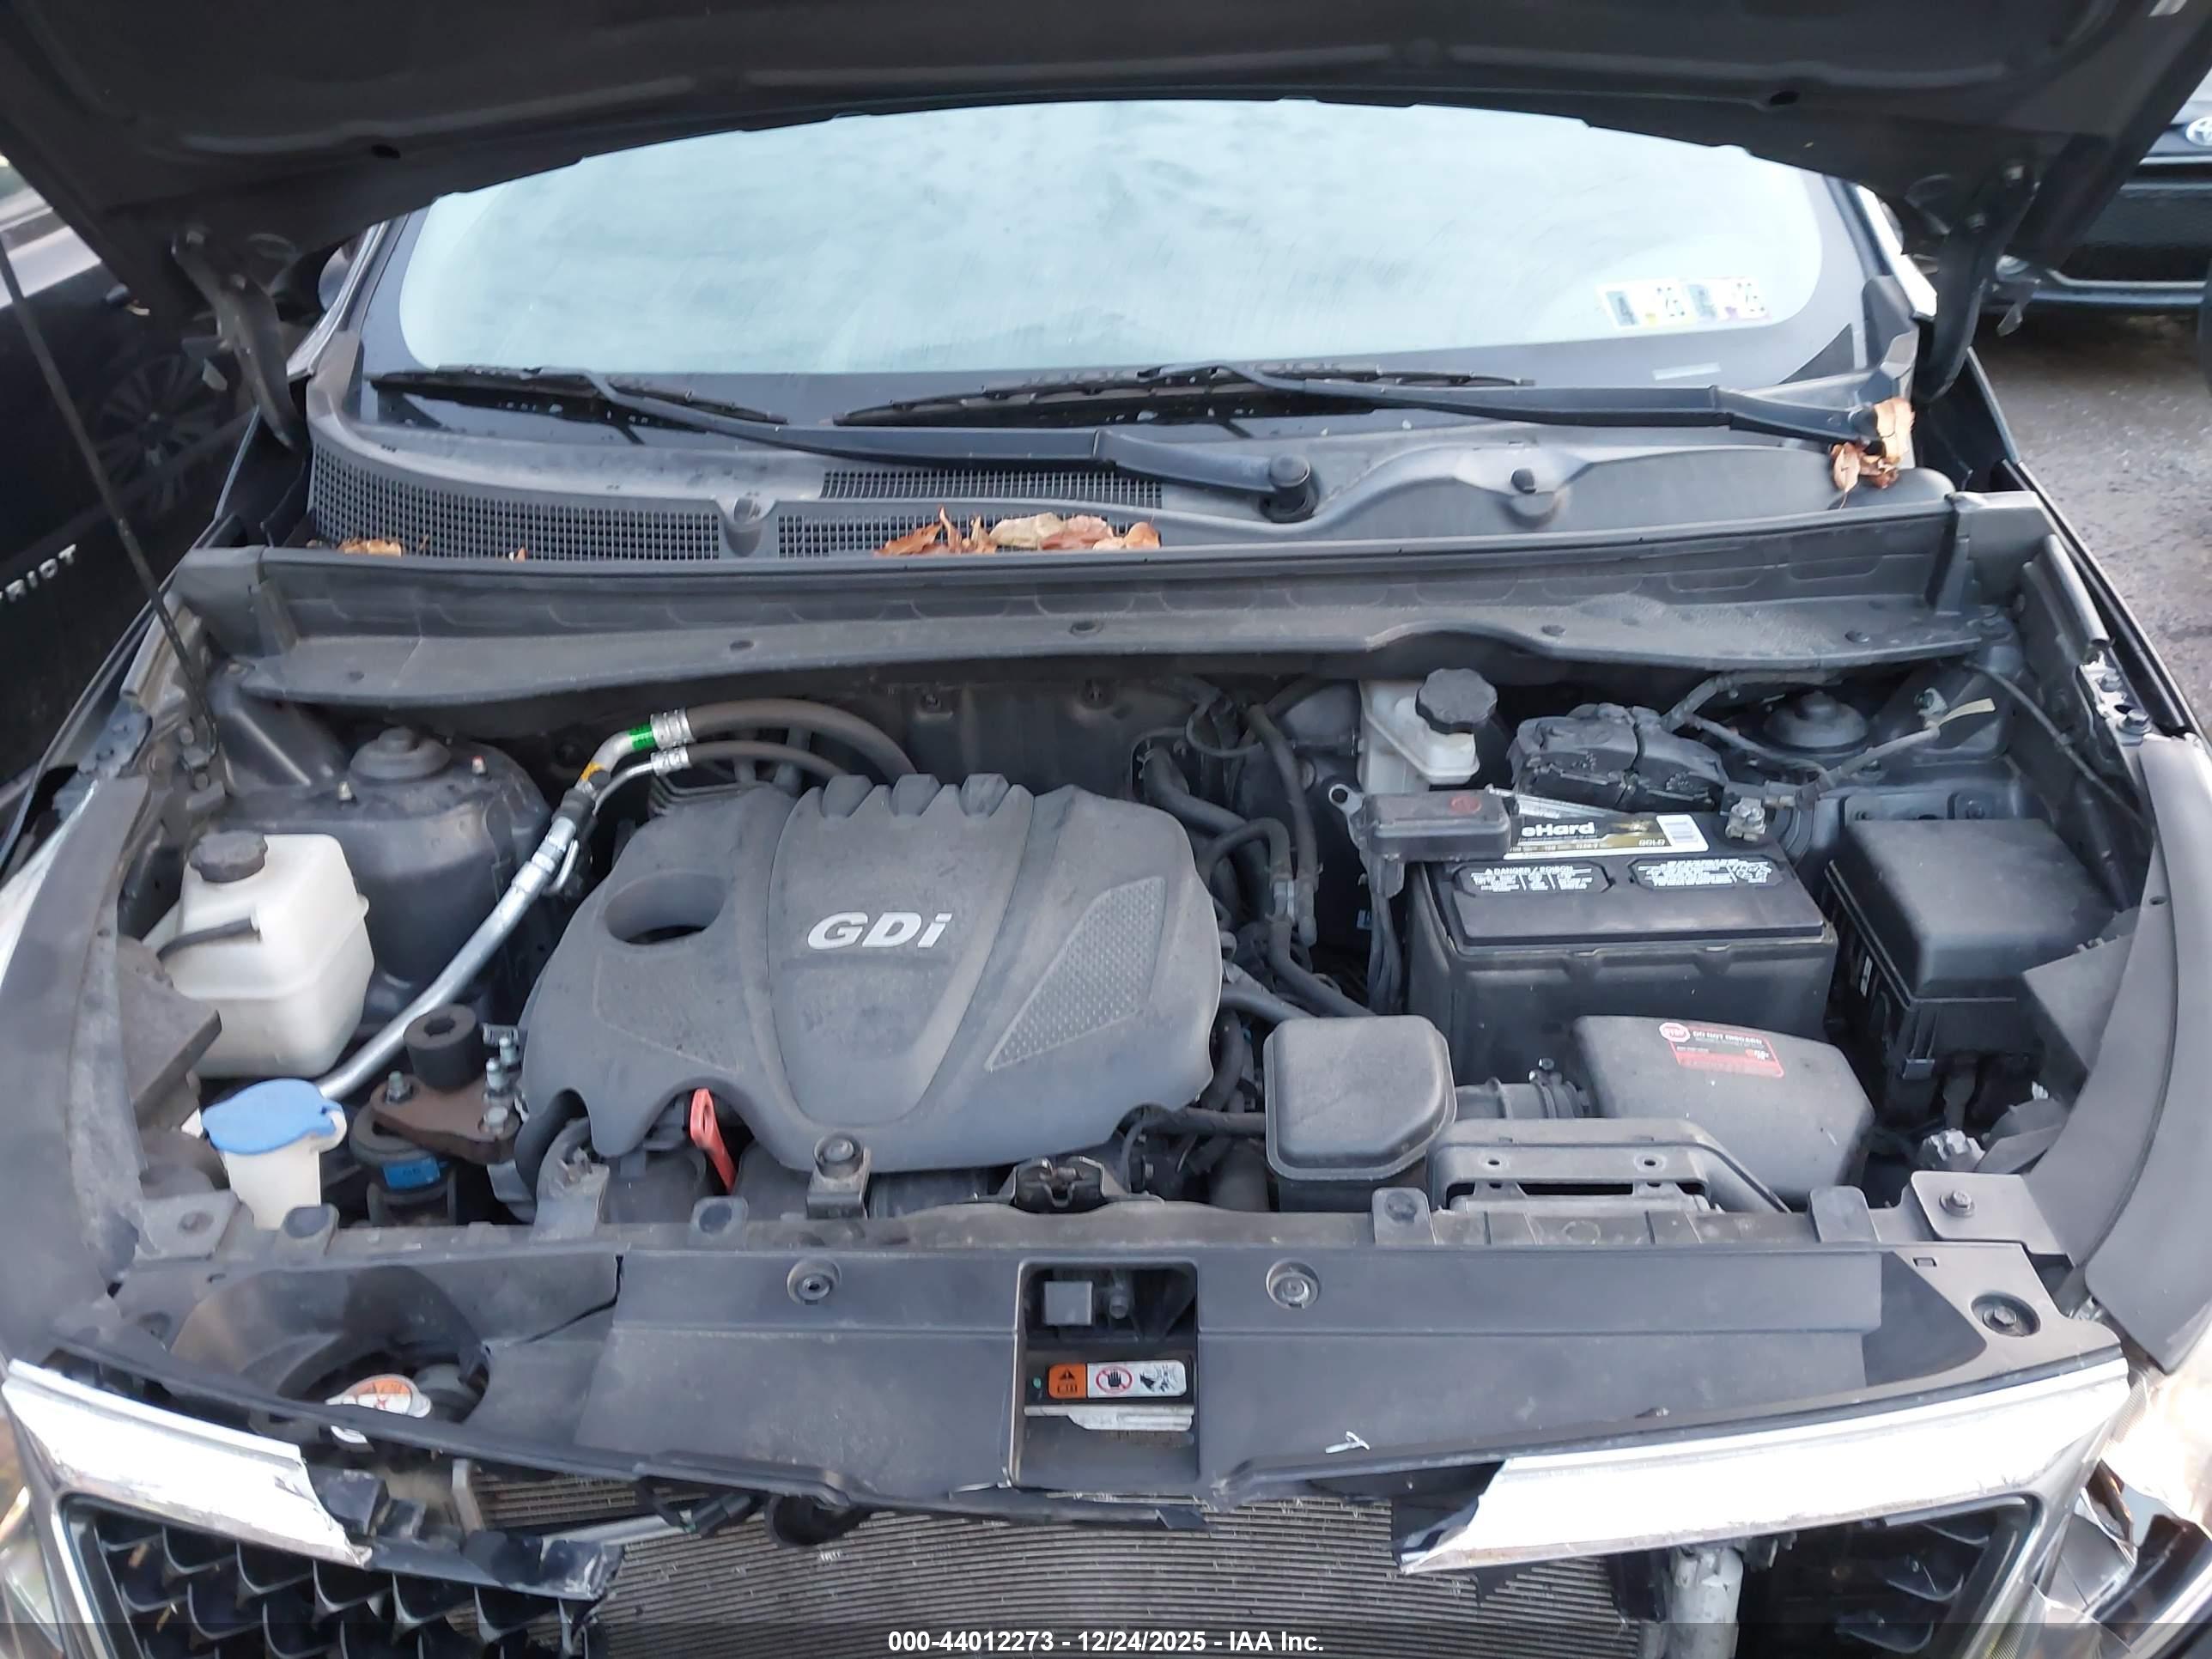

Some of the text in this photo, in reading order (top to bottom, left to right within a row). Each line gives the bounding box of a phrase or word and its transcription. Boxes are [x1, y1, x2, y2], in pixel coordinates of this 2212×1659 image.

[0, 543, 77, 602] RIOT
[1522, 822, 1595, 837] eHard
[808, 911, 953, 950] GDi
